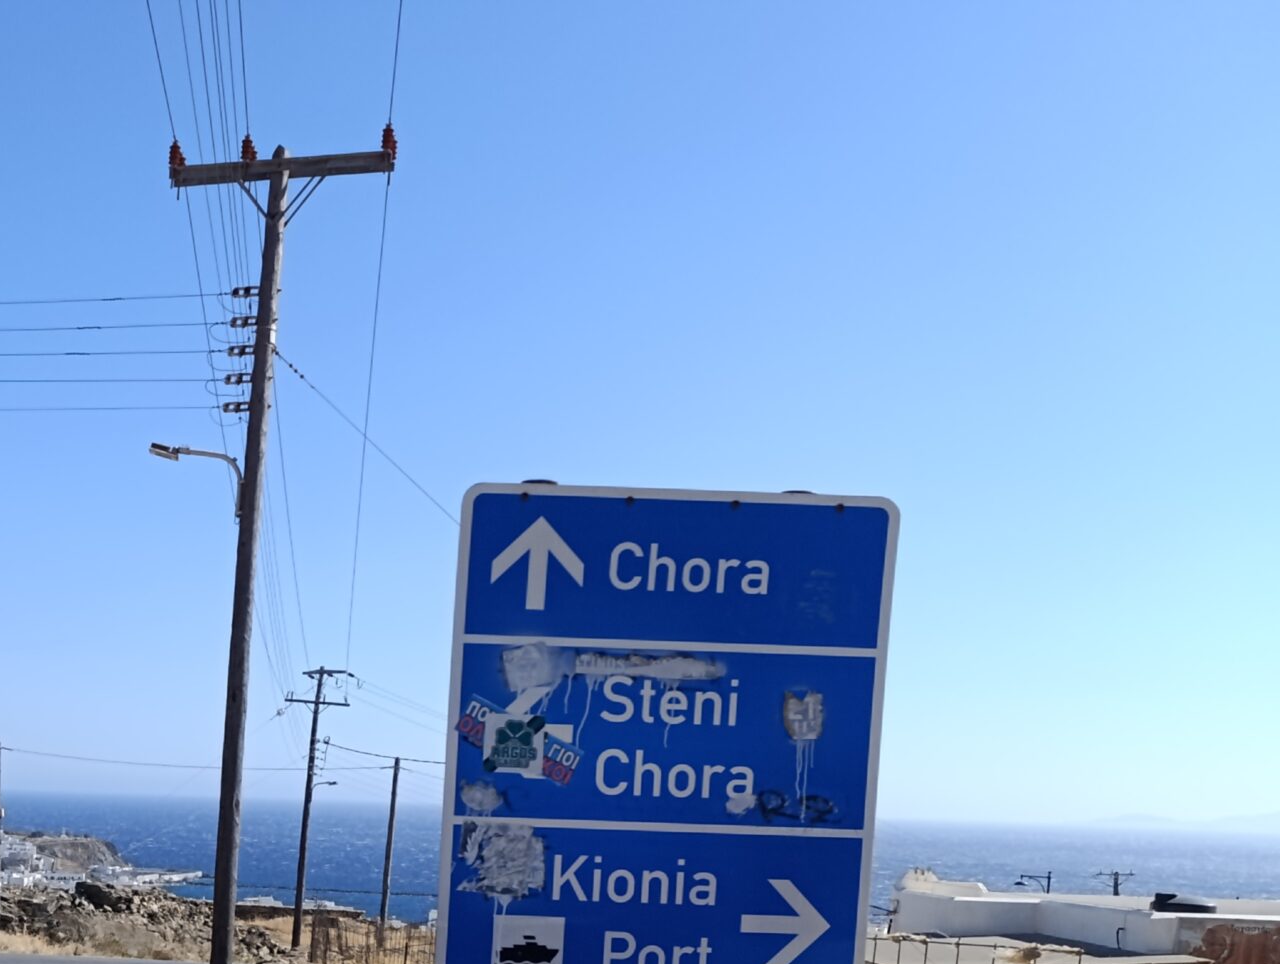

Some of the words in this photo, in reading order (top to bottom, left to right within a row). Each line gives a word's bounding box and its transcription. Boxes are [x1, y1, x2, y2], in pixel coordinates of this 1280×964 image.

[607, 541, 771, 596] Chora
[599, 674, 740, 727] Steni
[594, 747, 756, 800] Chora
[550, 852, 718, 906] Kionia
